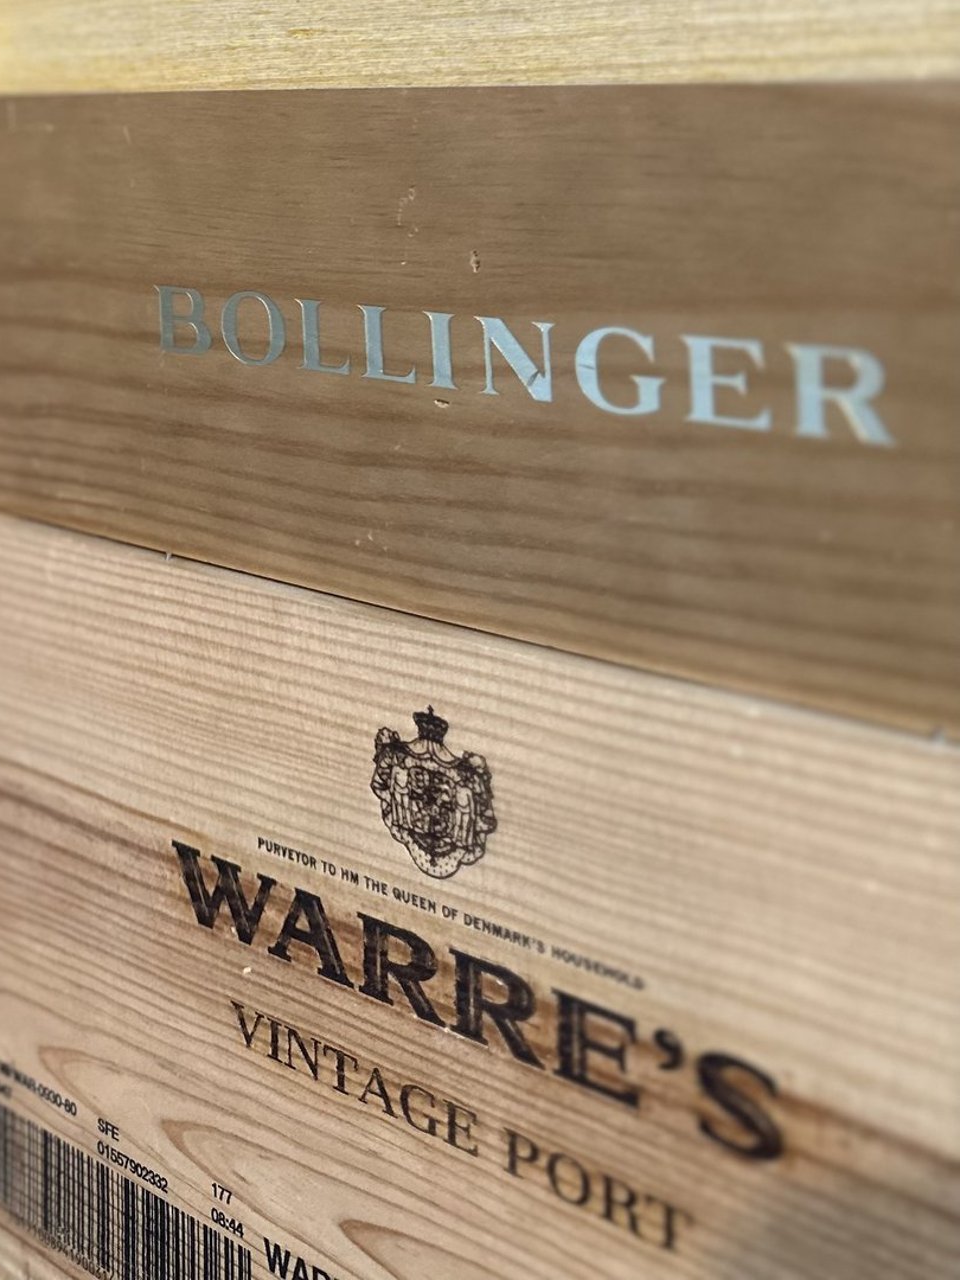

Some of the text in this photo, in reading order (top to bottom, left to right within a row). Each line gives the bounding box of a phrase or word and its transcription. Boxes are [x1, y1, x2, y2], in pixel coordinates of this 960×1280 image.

[152, 283, 896, 448] BOLLINGER
[257, 836, 318, 870] PURVEYOR
[321, 859, 337, 876] TO
[340, 867, 359, 886] HM
[363, 875, 389, 896] THE
[392, 886, 437, 914] QUEEN
[442, 904, 458, 921] OF
[464, 912, 546, 955] DENMARK'S
[171, 836, 784, 1163] WARRE'S
[97, 1117, 120, 1142] SFE
[211, 1182, 233, 1205] 177
[230, 1000, 697, 1256] VINTAGE PORT
